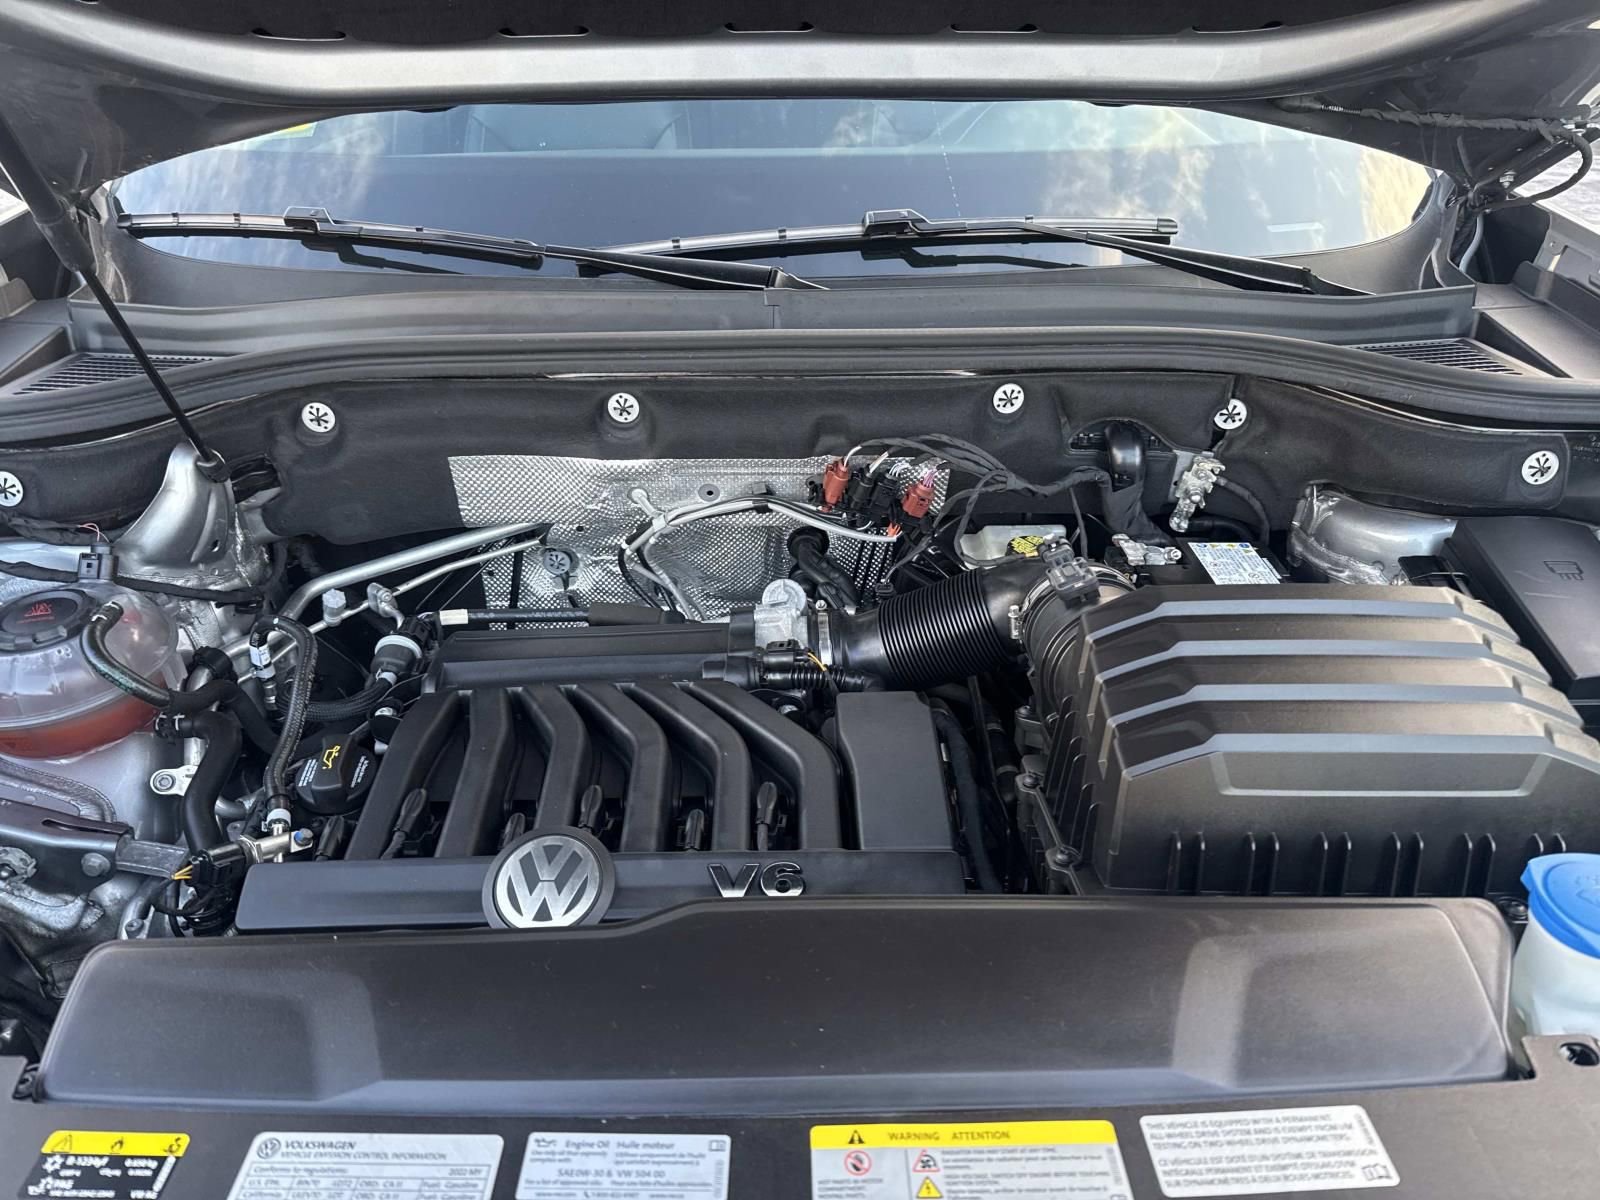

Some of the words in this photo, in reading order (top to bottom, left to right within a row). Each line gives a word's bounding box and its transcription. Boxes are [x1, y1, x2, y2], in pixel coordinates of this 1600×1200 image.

[708, 861, 806, 898] V6
[888, 1132, 940, 1141] WARNING
[951, 1130, 1010, 1141] ATTENTION
[286, 1140, 357, 1150] VOLKSWAGEN
[565, 1139, 595, 1150] Engine
[597, 1140, 610, 1149] Oil
[616, 1140, 641, 1149] Huile
[642, 1141, 676, 1149] moteur
